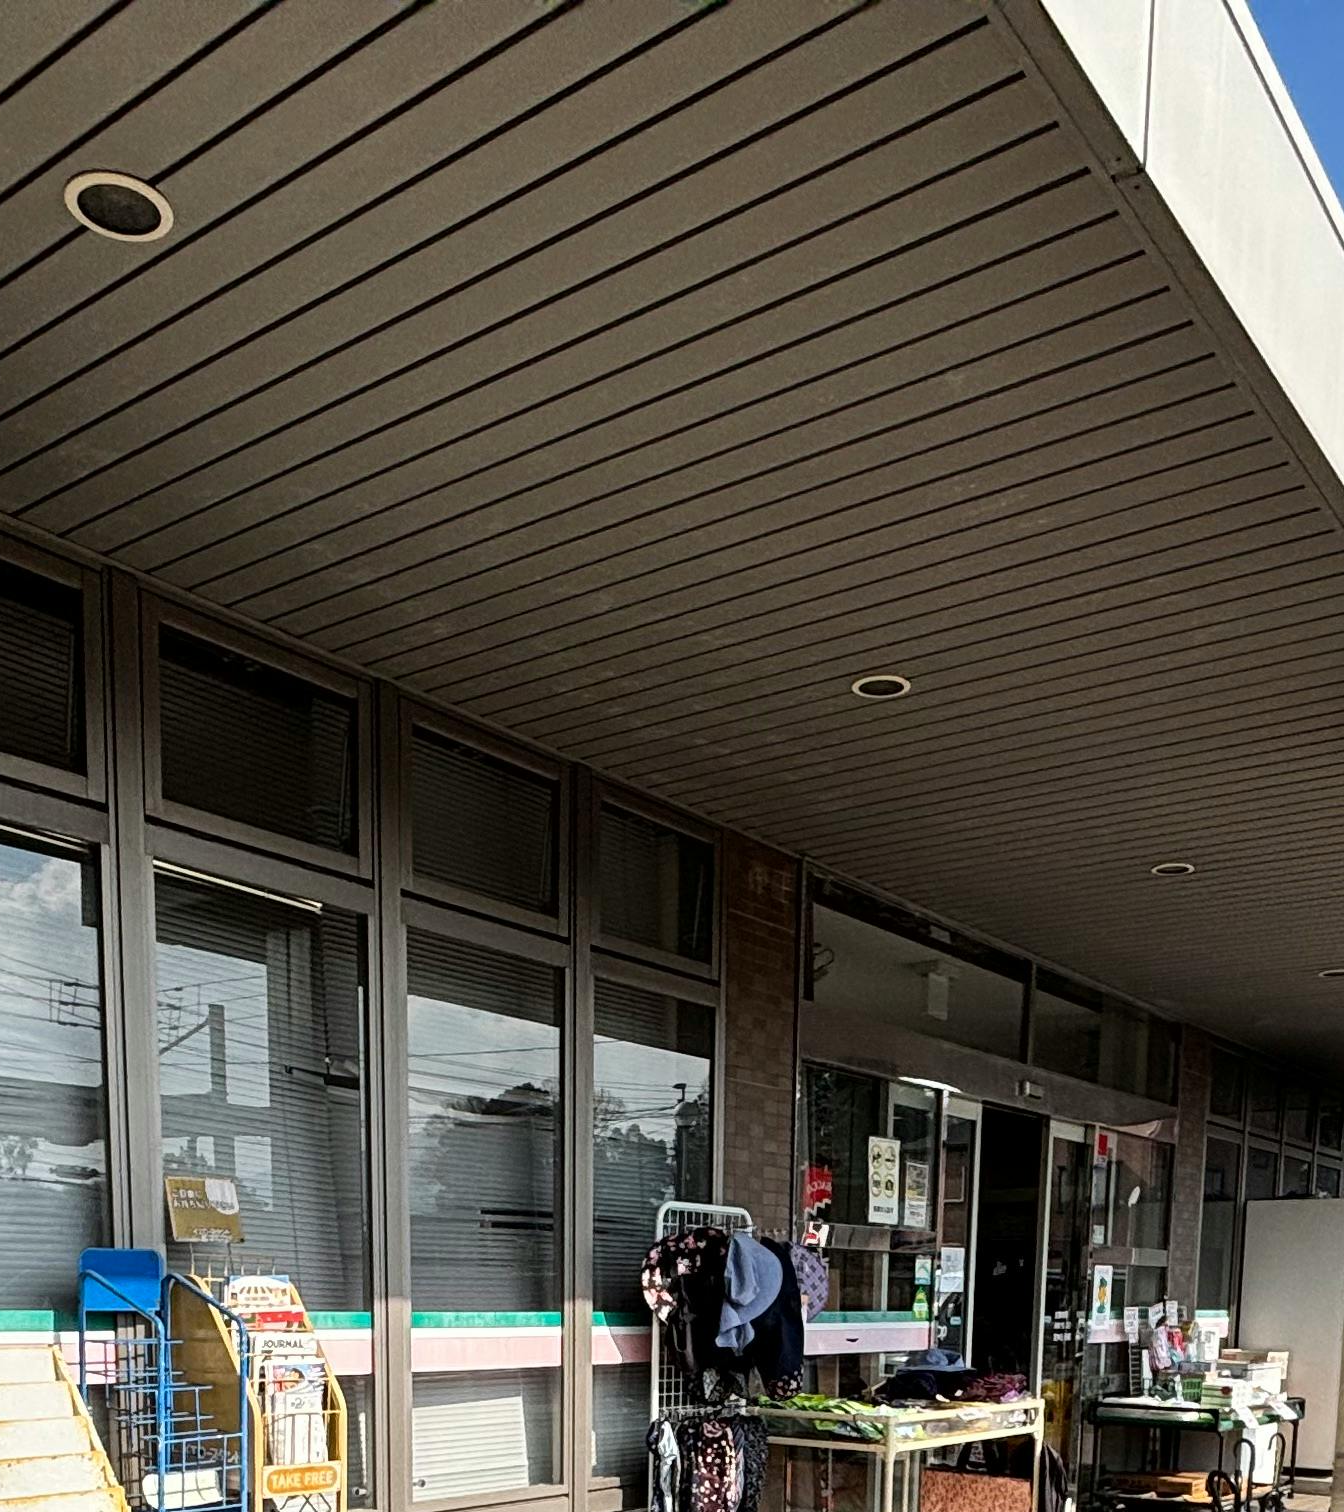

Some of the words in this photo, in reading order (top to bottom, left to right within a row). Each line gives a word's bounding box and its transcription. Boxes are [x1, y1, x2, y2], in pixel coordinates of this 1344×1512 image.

[261, 1338, 305, 1349] JOURNAL
[270, 1473, 303, 1490] TAKE
[303, 1470, 334, 1487] FREE
